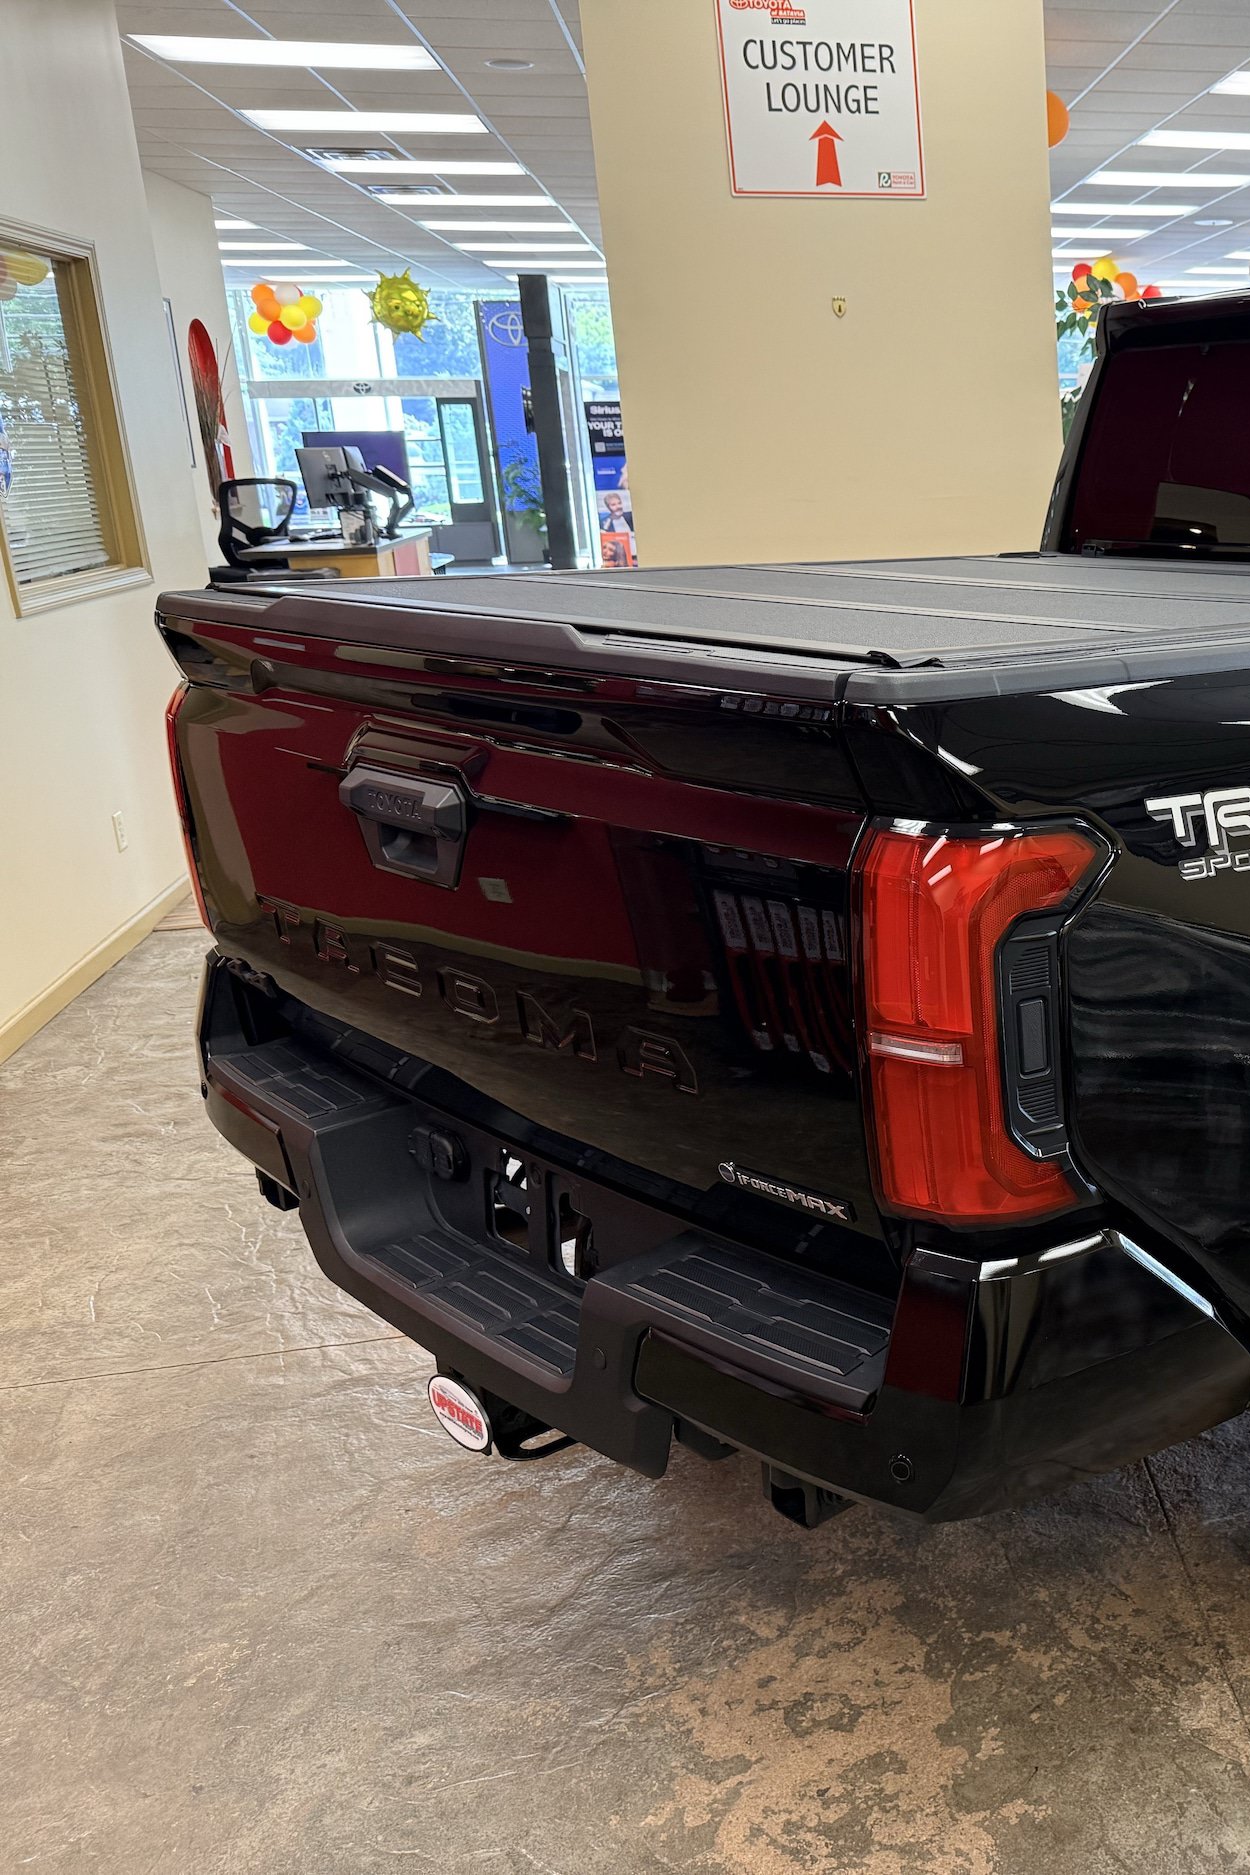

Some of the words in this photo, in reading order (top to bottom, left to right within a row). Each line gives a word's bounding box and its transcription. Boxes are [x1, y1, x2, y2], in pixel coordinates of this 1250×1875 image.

[742, 38, 896, 74] CUSTOMER
[766, 82, 880, 115] LOUNGE
[587, 421, 614, 430] YOUR
[602, 429, 613, 438] IS
[254, 892, 699, 1095] TACOMA
[431, 1387, 483, 1434] UPSTATE
